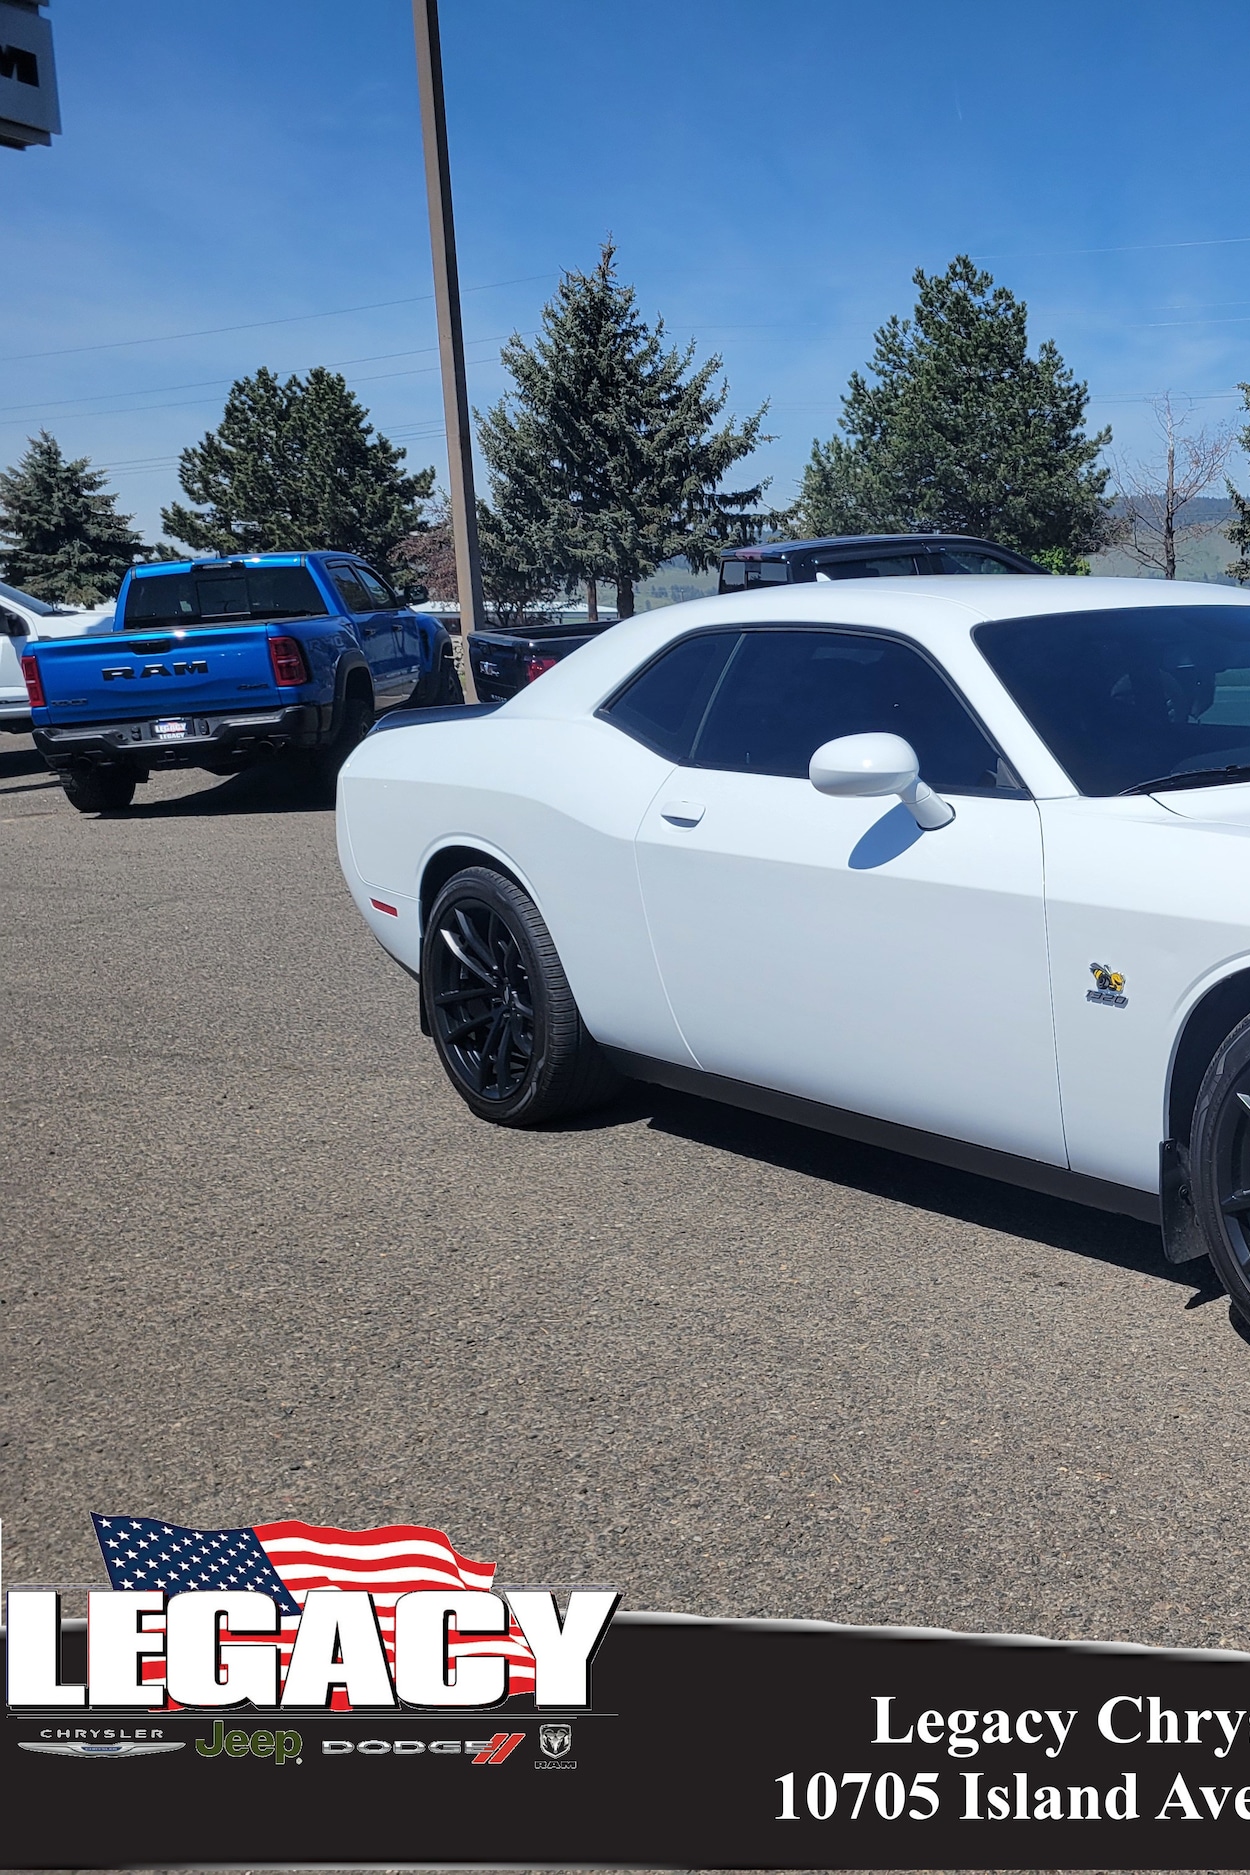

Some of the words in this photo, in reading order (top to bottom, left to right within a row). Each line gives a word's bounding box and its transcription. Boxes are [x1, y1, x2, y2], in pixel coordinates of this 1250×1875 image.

[101, 660, 209, 682] RAM
[154, 721, 187, 734] LEGACY
[159, 732, 185, 740] LEGACY
[1085, 989, 1129, 1009] 1320
